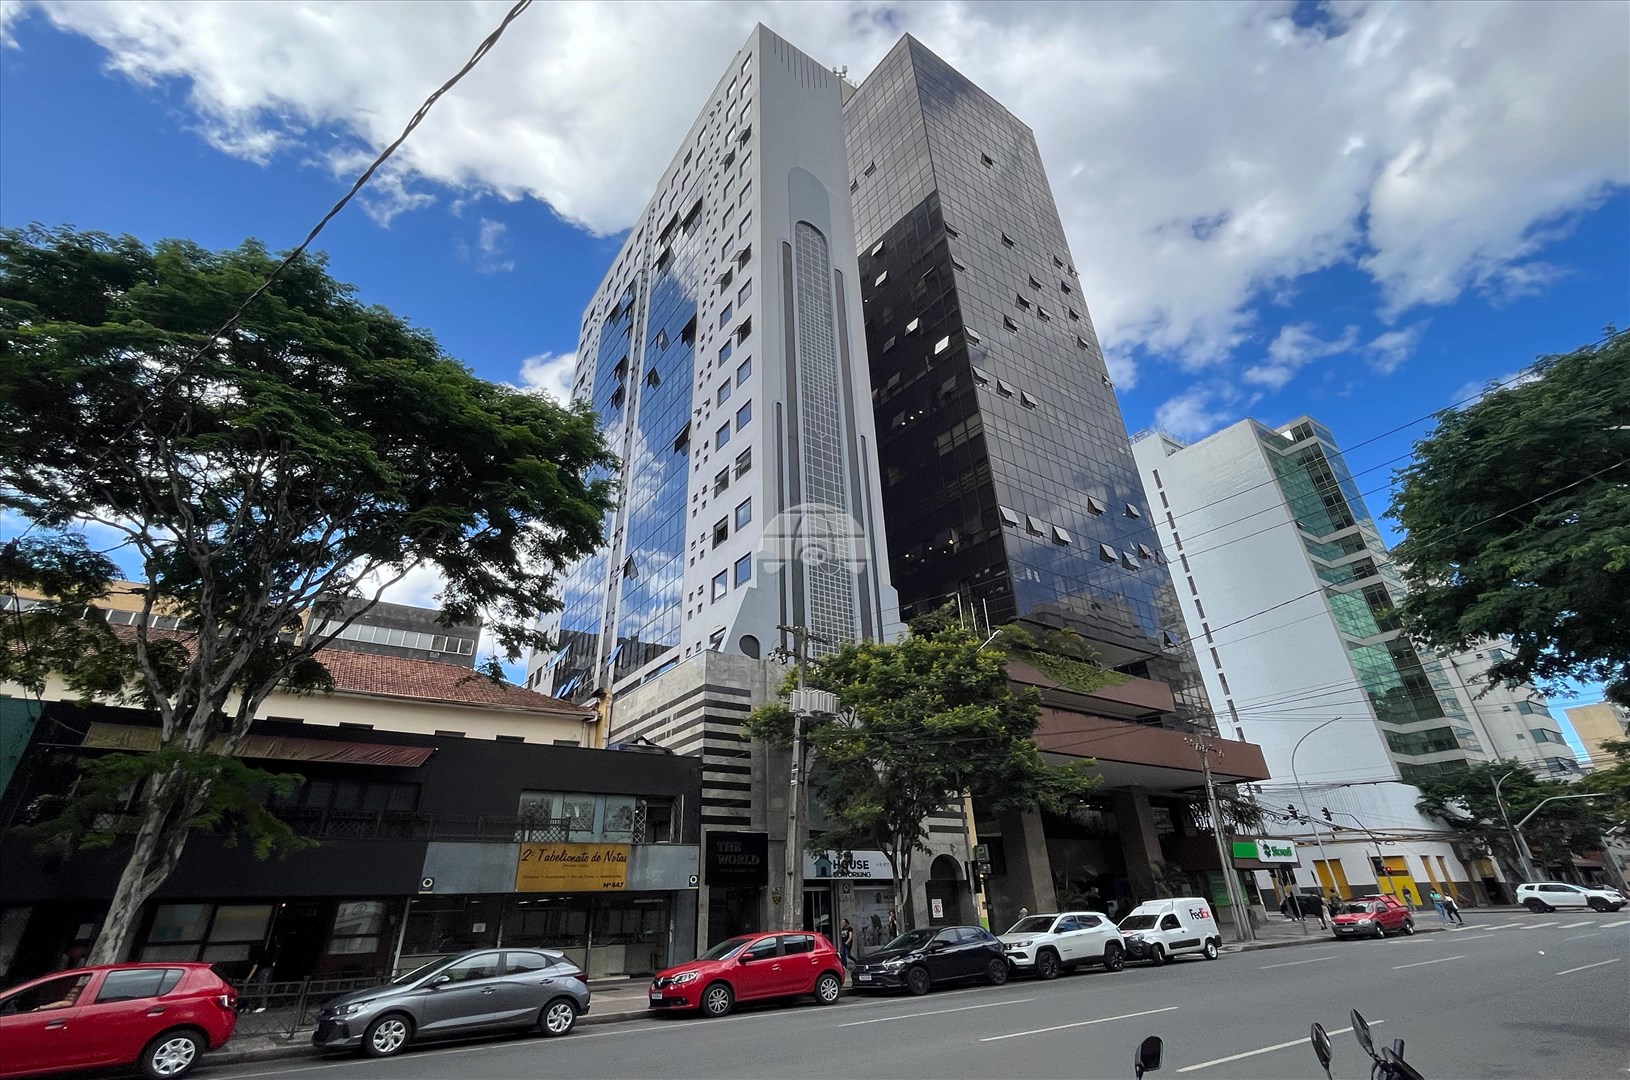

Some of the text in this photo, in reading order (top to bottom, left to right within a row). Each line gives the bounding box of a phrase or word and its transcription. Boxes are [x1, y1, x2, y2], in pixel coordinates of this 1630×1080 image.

[538, 848, 589, 863] Tabelionato
[591, 851, 602, 863] de
[604, 850, 628, 863] Notas
[717, 854, 760, 865] WORLD
[833, 859, 870, 870] HUSE
[1189, 908, 1211, 920] FedEx
